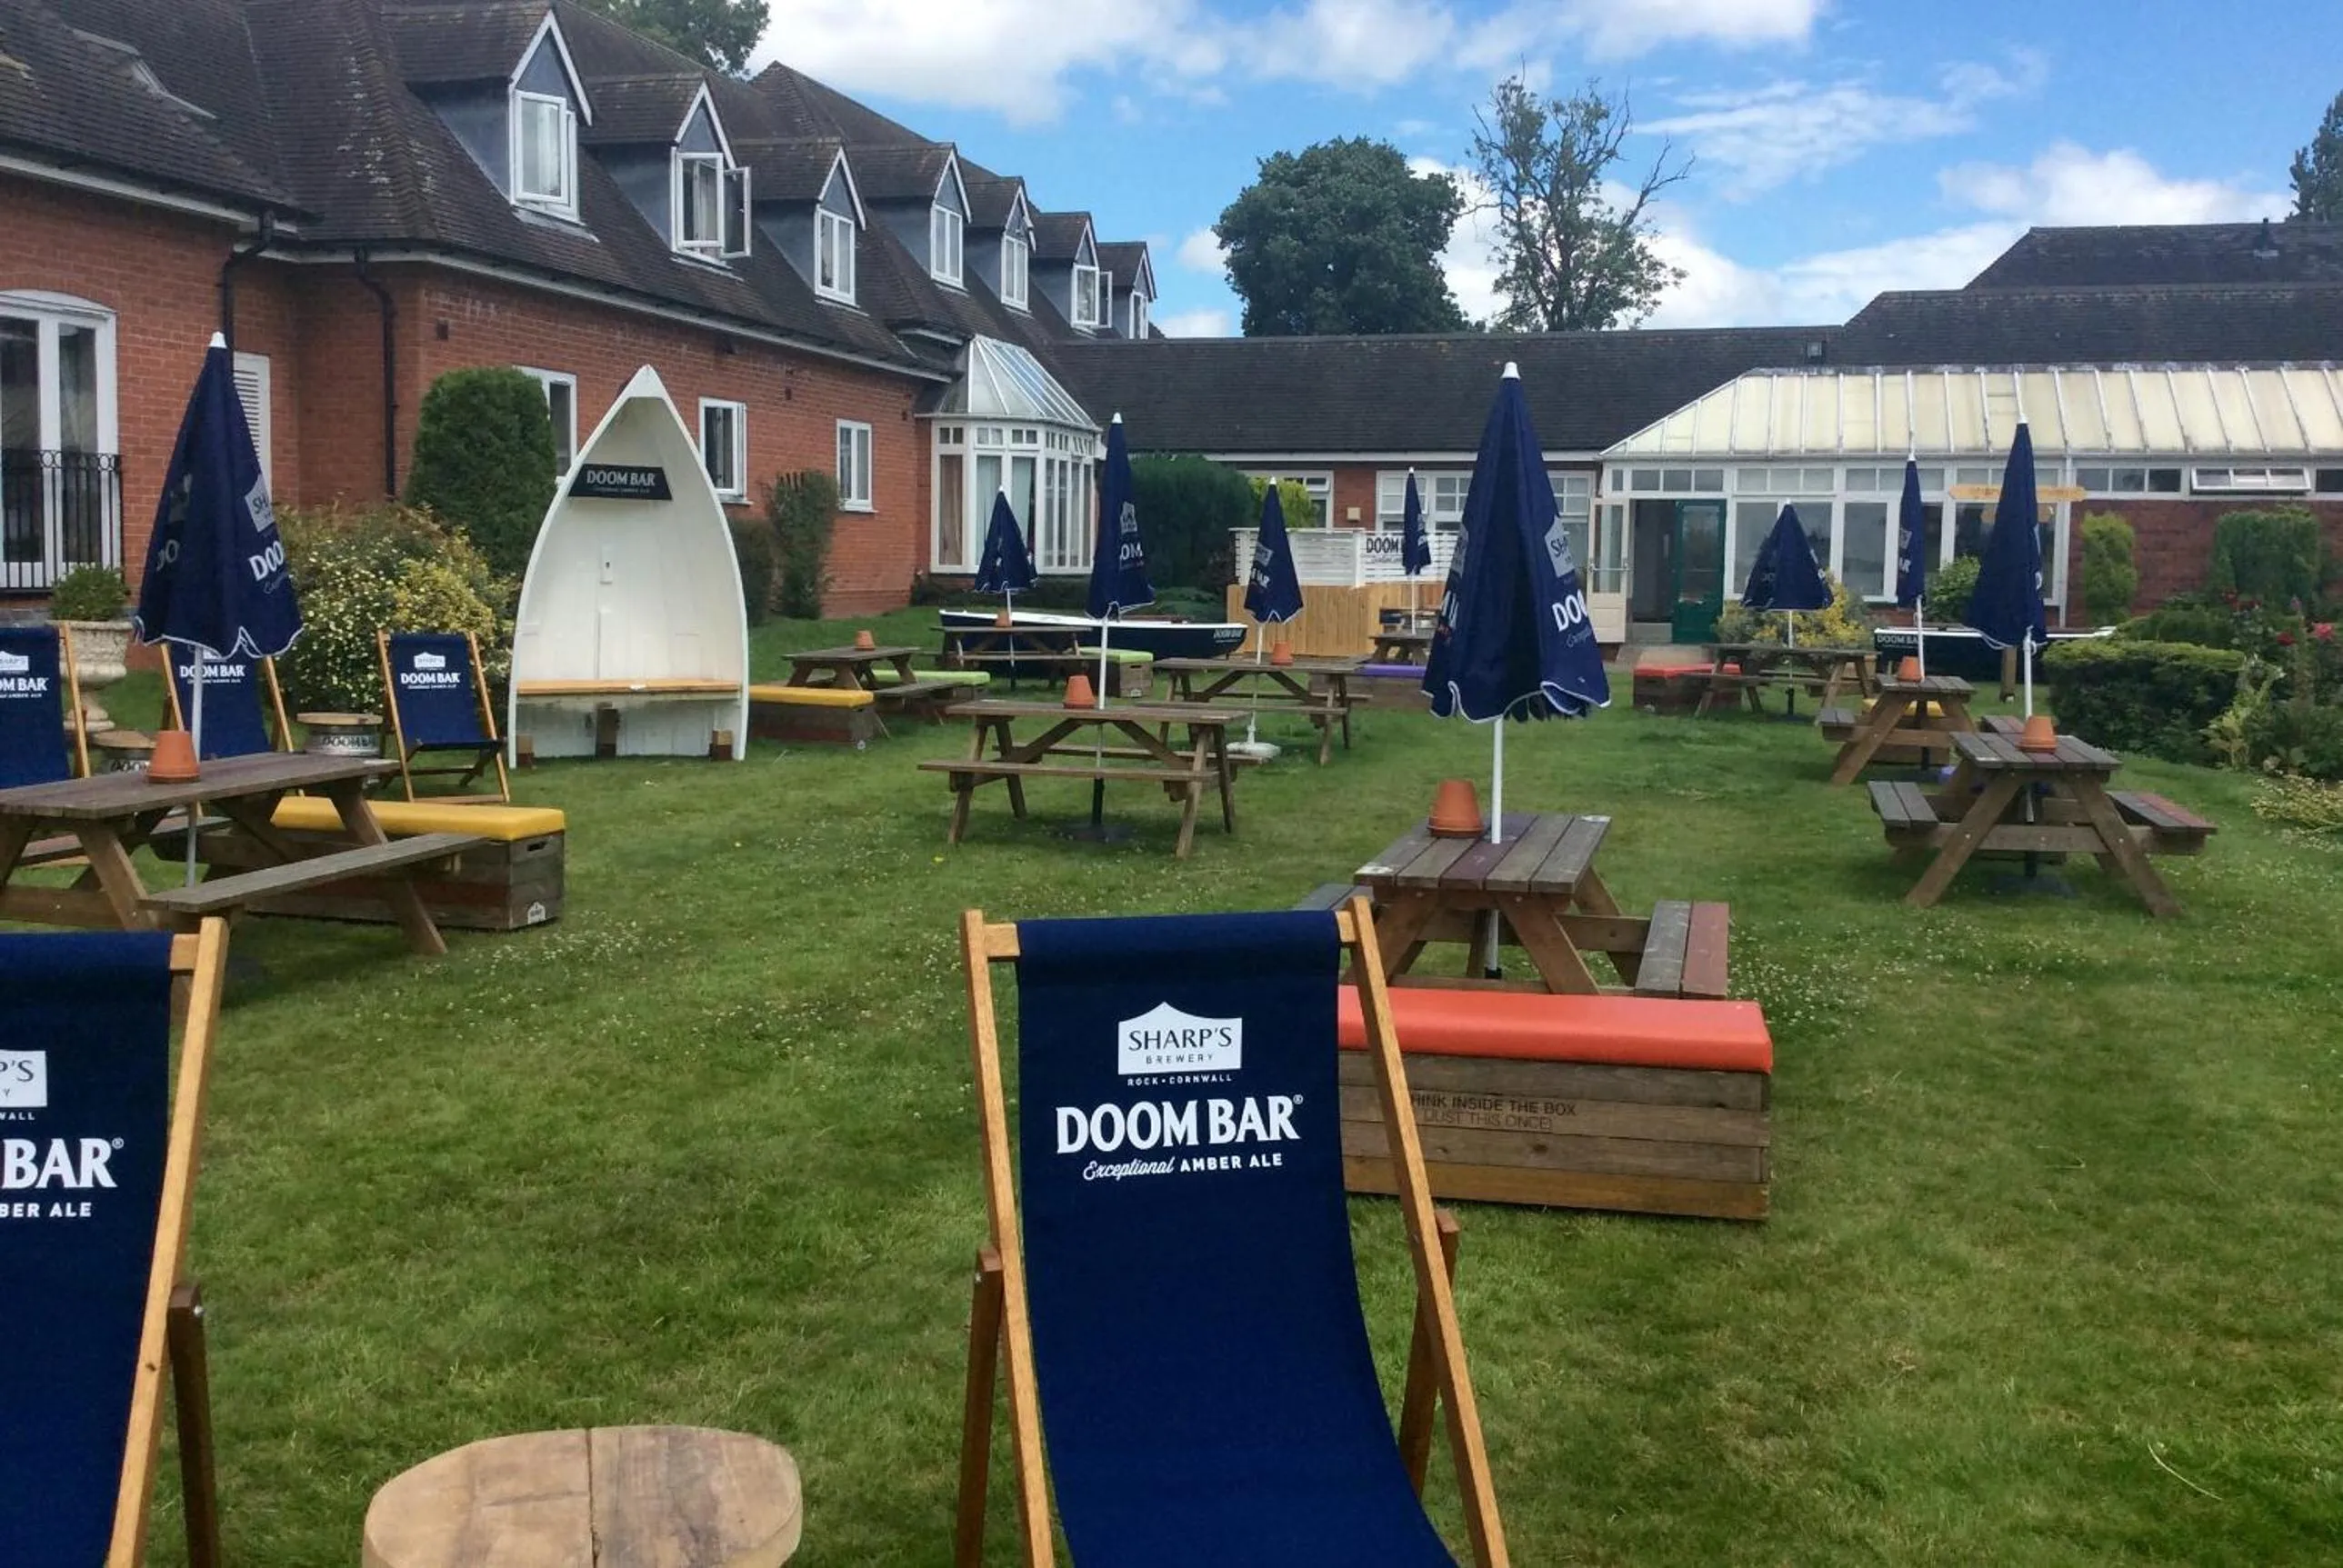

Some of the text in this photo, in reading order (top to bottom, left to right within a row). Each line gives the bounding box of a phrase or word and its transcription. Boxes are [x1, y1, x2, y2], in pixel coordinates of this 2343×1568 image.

[586, 470, 656, 486] DOOM BAR
[1366, 537, 1399, 554] DOOM
[220, 665, 245, 677] BAR
[400, 673, 436, 684] DOOM
[17, 677, 49, 691] BAR
[1127, 1027, 1233, 1052] SHARP'S
[1146, 1054, 1214, 1065] BREWERY
[1126, 1074, 1233, 1087] ROCK CORNWALL
[1451, 1095, 1503, 1111] INSIDE
[1509, 1099, 1539, 1114] THE
[1544, 1102, 1577, 1117] BOX
[1055, 1099, 1200, 1154] DOOM
[1082, 1153, 1283, 1182] Exceptional AMBER ALE
[49, 1202, 92, 1218] ALE
